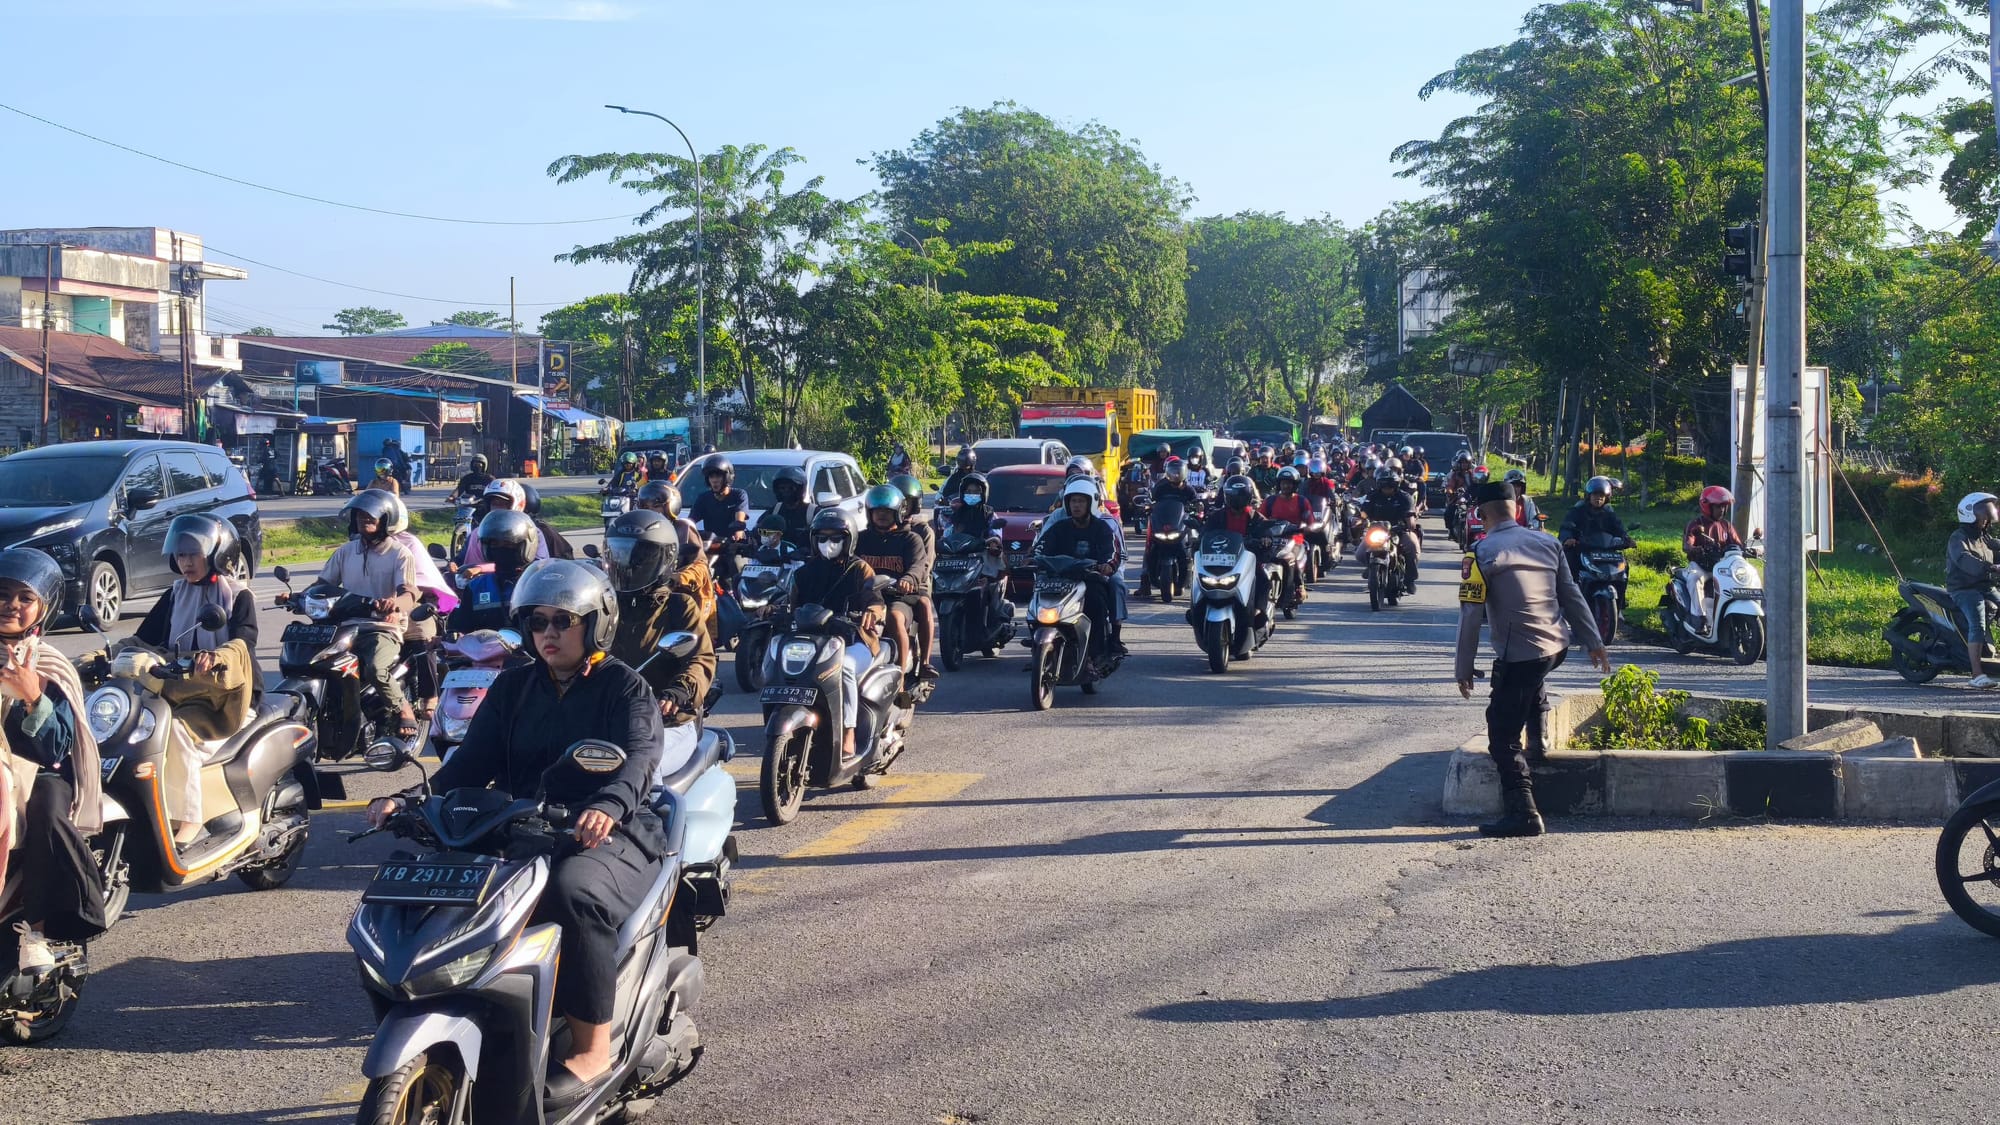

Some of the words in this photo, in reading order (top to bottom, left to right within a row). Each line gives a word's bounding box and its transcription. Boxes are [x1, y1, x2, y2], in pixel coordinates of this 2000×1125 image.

[381, 866, 408, 881] KB
[411, 868, 455, 883] 2911
[460, 869, 484, 883] SX
